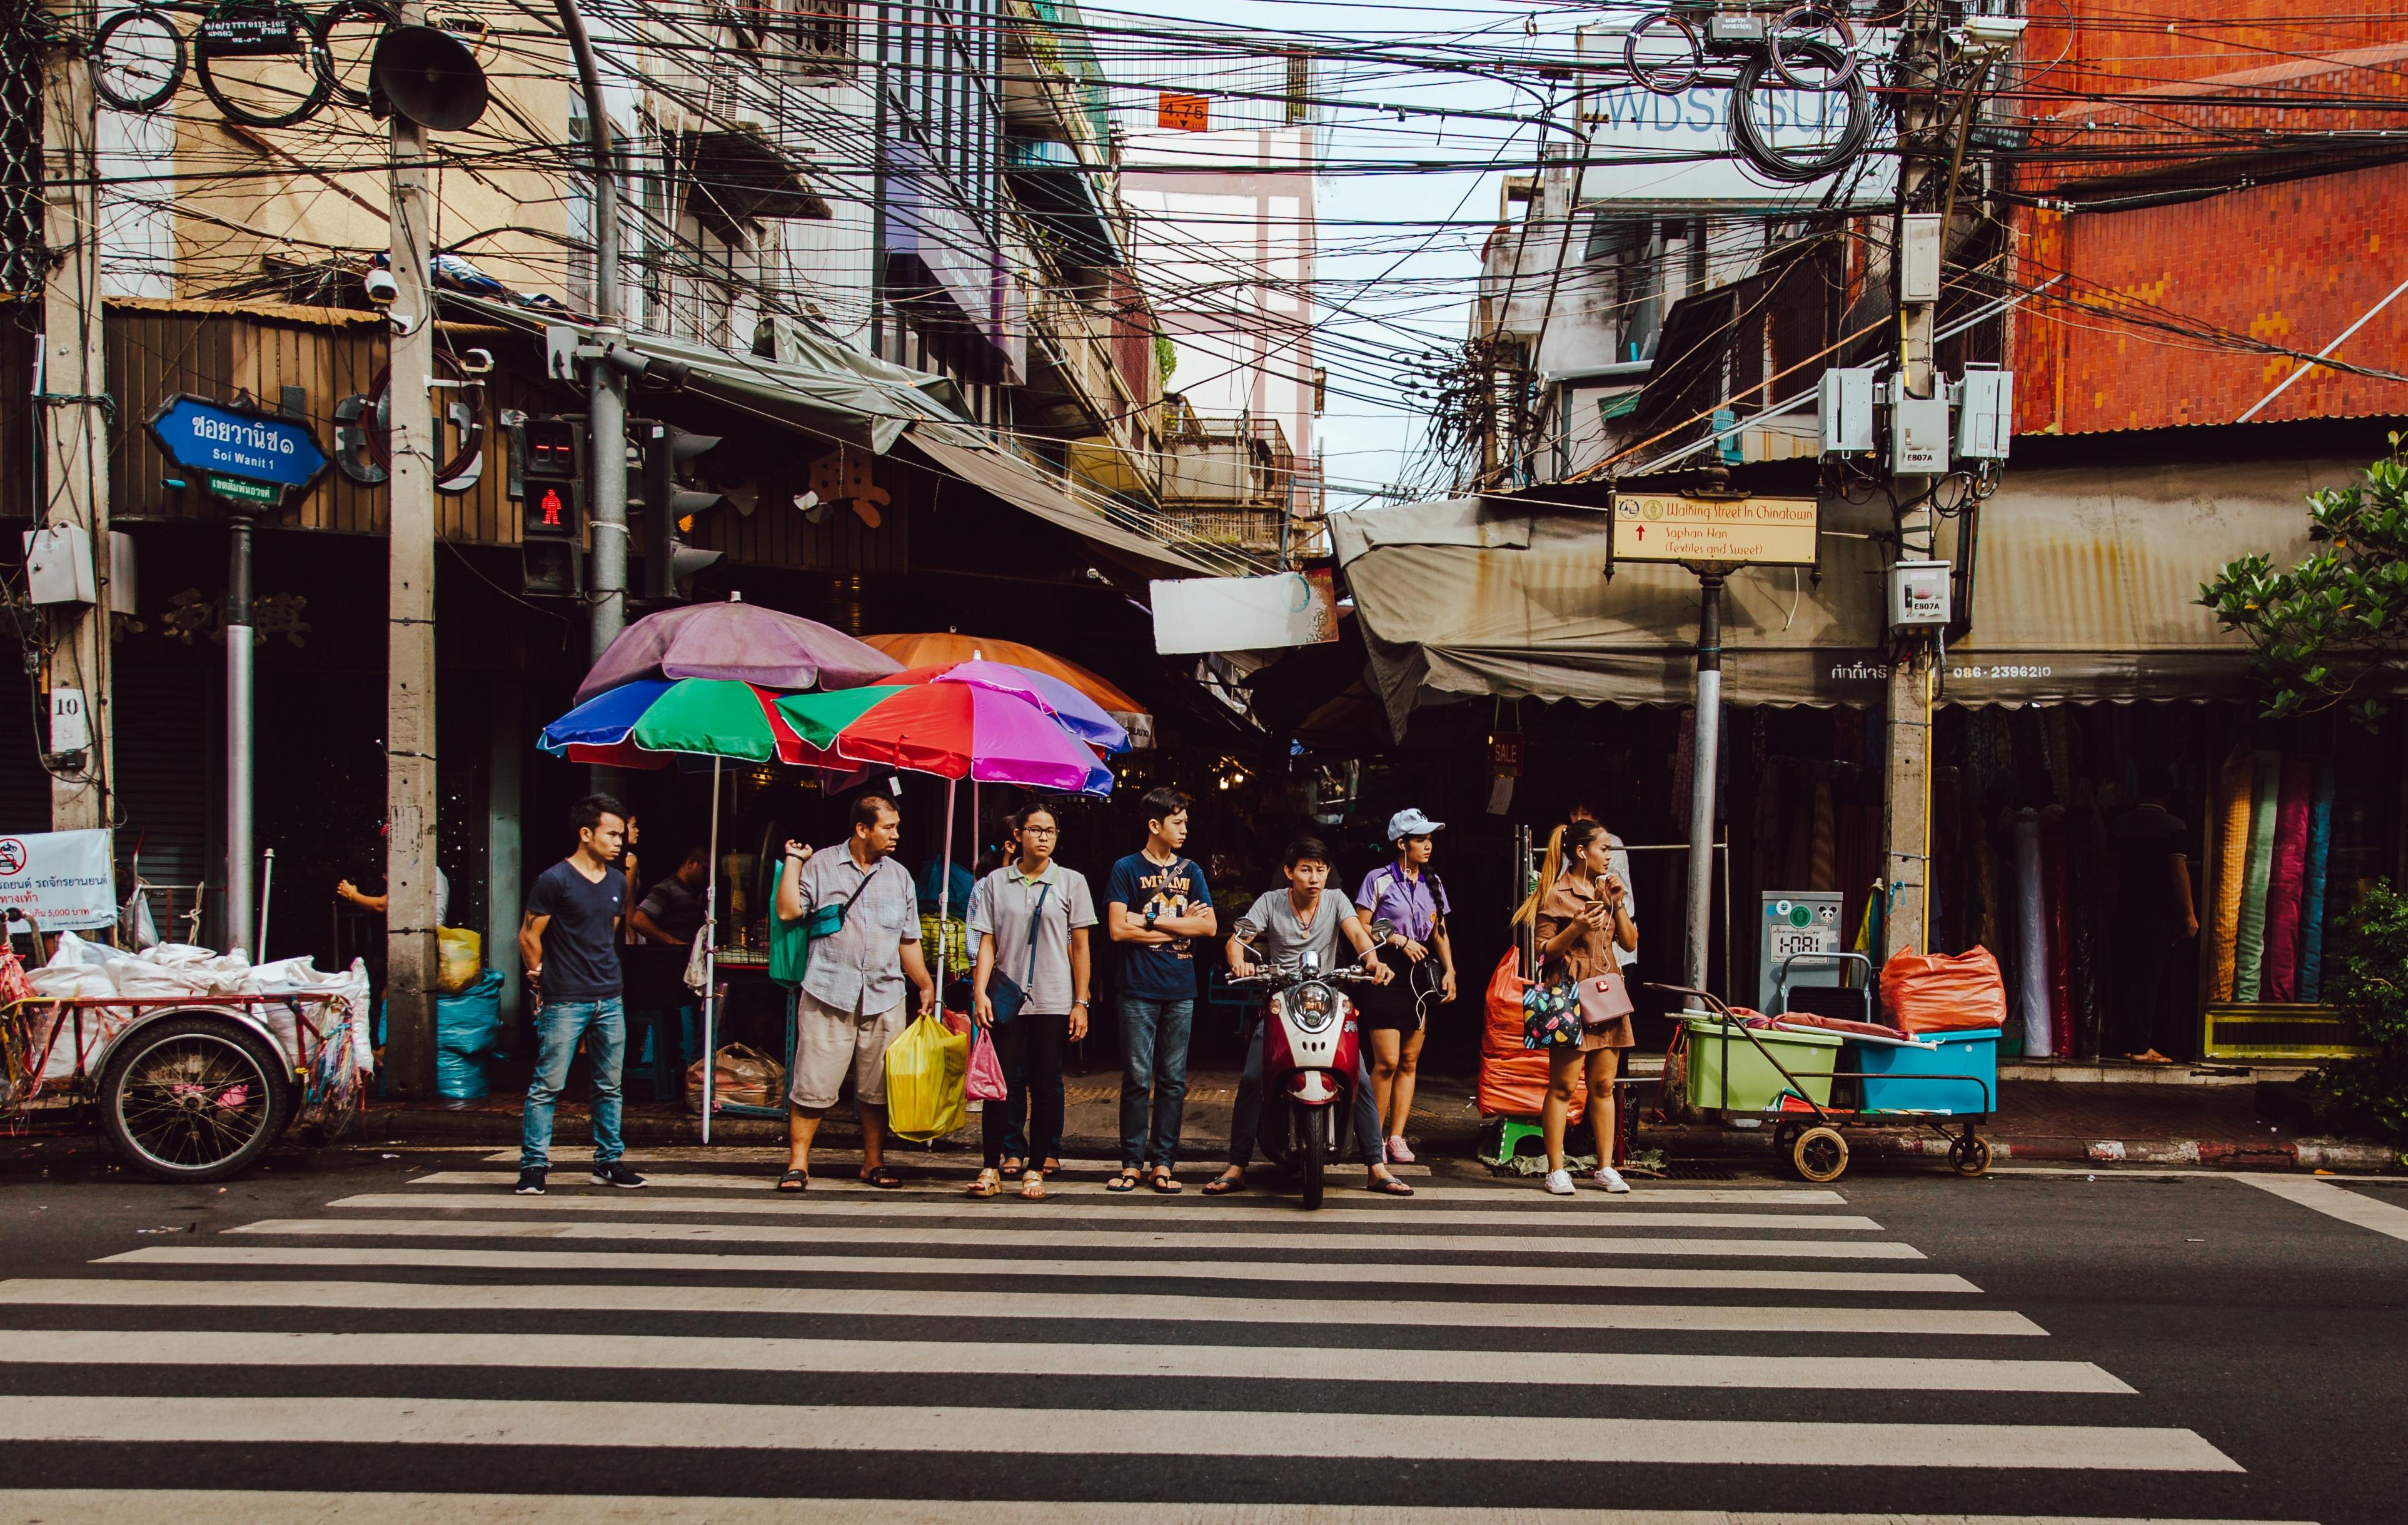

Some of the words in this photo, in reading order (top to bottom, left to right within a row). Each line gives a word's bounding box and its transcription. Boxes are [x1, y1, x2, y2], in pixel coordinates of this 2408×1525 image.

[1164, 103, 1204, 119] 4.75
[213, 448, 231, 461] Soi
[234, 452, 266, 468] Wanit
[269, 460, 273, 470] 1
[1907, 453, 1933, 461] E807A
[1666, 502, 1710, 521] Walking
[1714, 503, 1740, 518] Street
[1745, 505, 1753, 517] In
[1756, 505, 1813, 520] Chinatown
[1666, 526, 1703, 540] Saphan
[1707, 528, 1727, 538] Han
[1665, 542, 1703, 554] (Textiles
[1706, 543, 1726, 555] and
[1730, 543, 1763, 555] Sweet)
[56, 698, 79, 715] 10
[1495, 743, 1516, 763] SALE
[48, 908, 70, 918] 5,000
[71, 908, 89, 916] บาท
